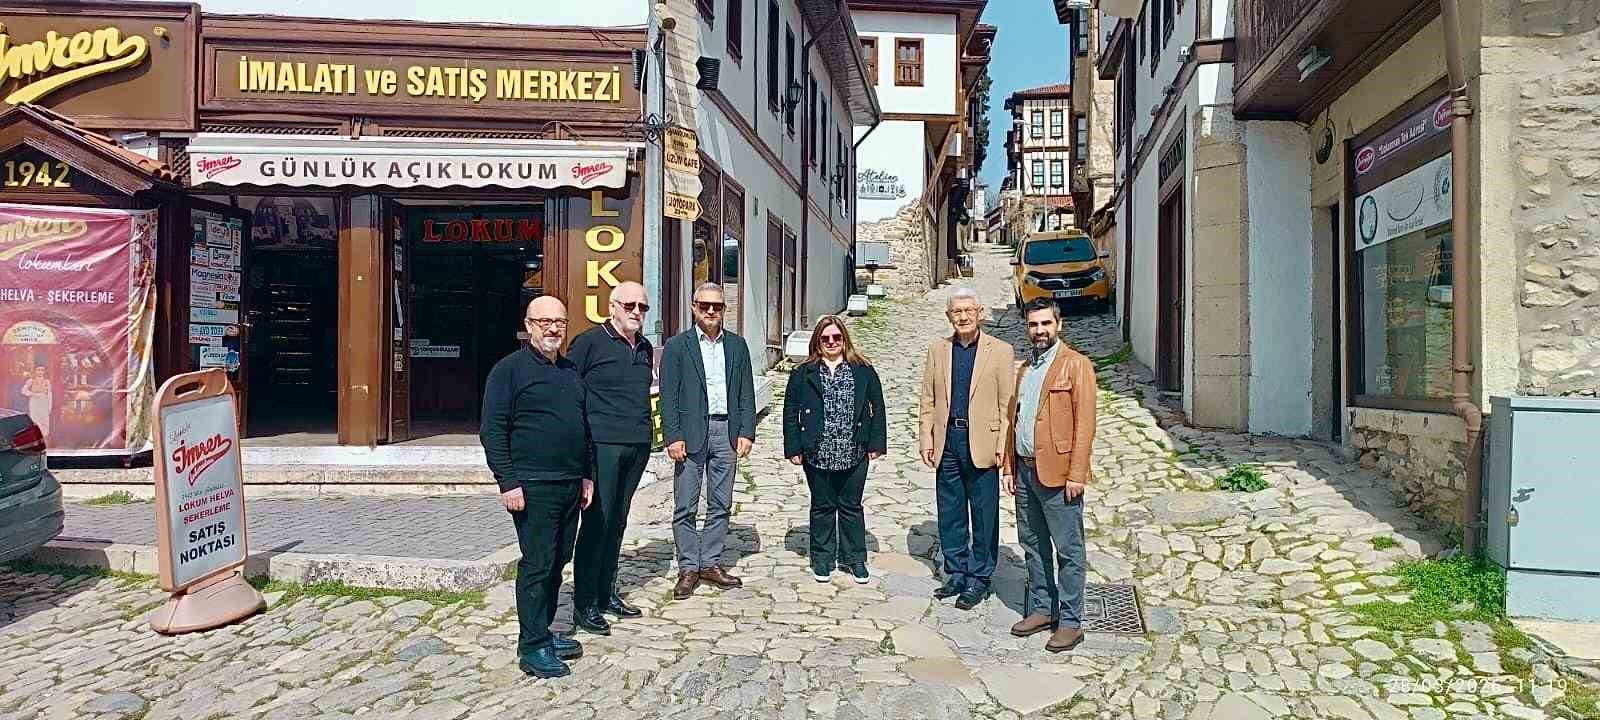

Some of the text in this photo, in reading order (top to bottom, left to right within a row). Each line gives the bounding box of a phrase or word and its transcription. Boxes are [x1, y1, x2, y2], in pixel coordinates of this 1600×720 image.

[0, 22, 148, 104] mren
[239, 55, 620, 101] İMALATI ve SATIŞ MERKEZİ
[4, 160, 71, 188] 1942
[196, 155, 241, 179] İmren
[259, 157, 557, 183] GÜNLÜK AÇIK LOKUM
[570, 162, 614, 185] İmren
[683, 155, 698, 169] CAFE
[422, 218, 545, 242] LOKUM
[0, 288, 35, 301] HELVA
[48, 290, 115, 305] ŞEKERLEME
[172, 432, 233, 485] İmren
[178, 497, 208, 513] LOKUM
[209, 488, 235, 503] HELVA
[189, 521, 226, 543] SATIŞ
[180, 534, 235, 564] NOKTASI
